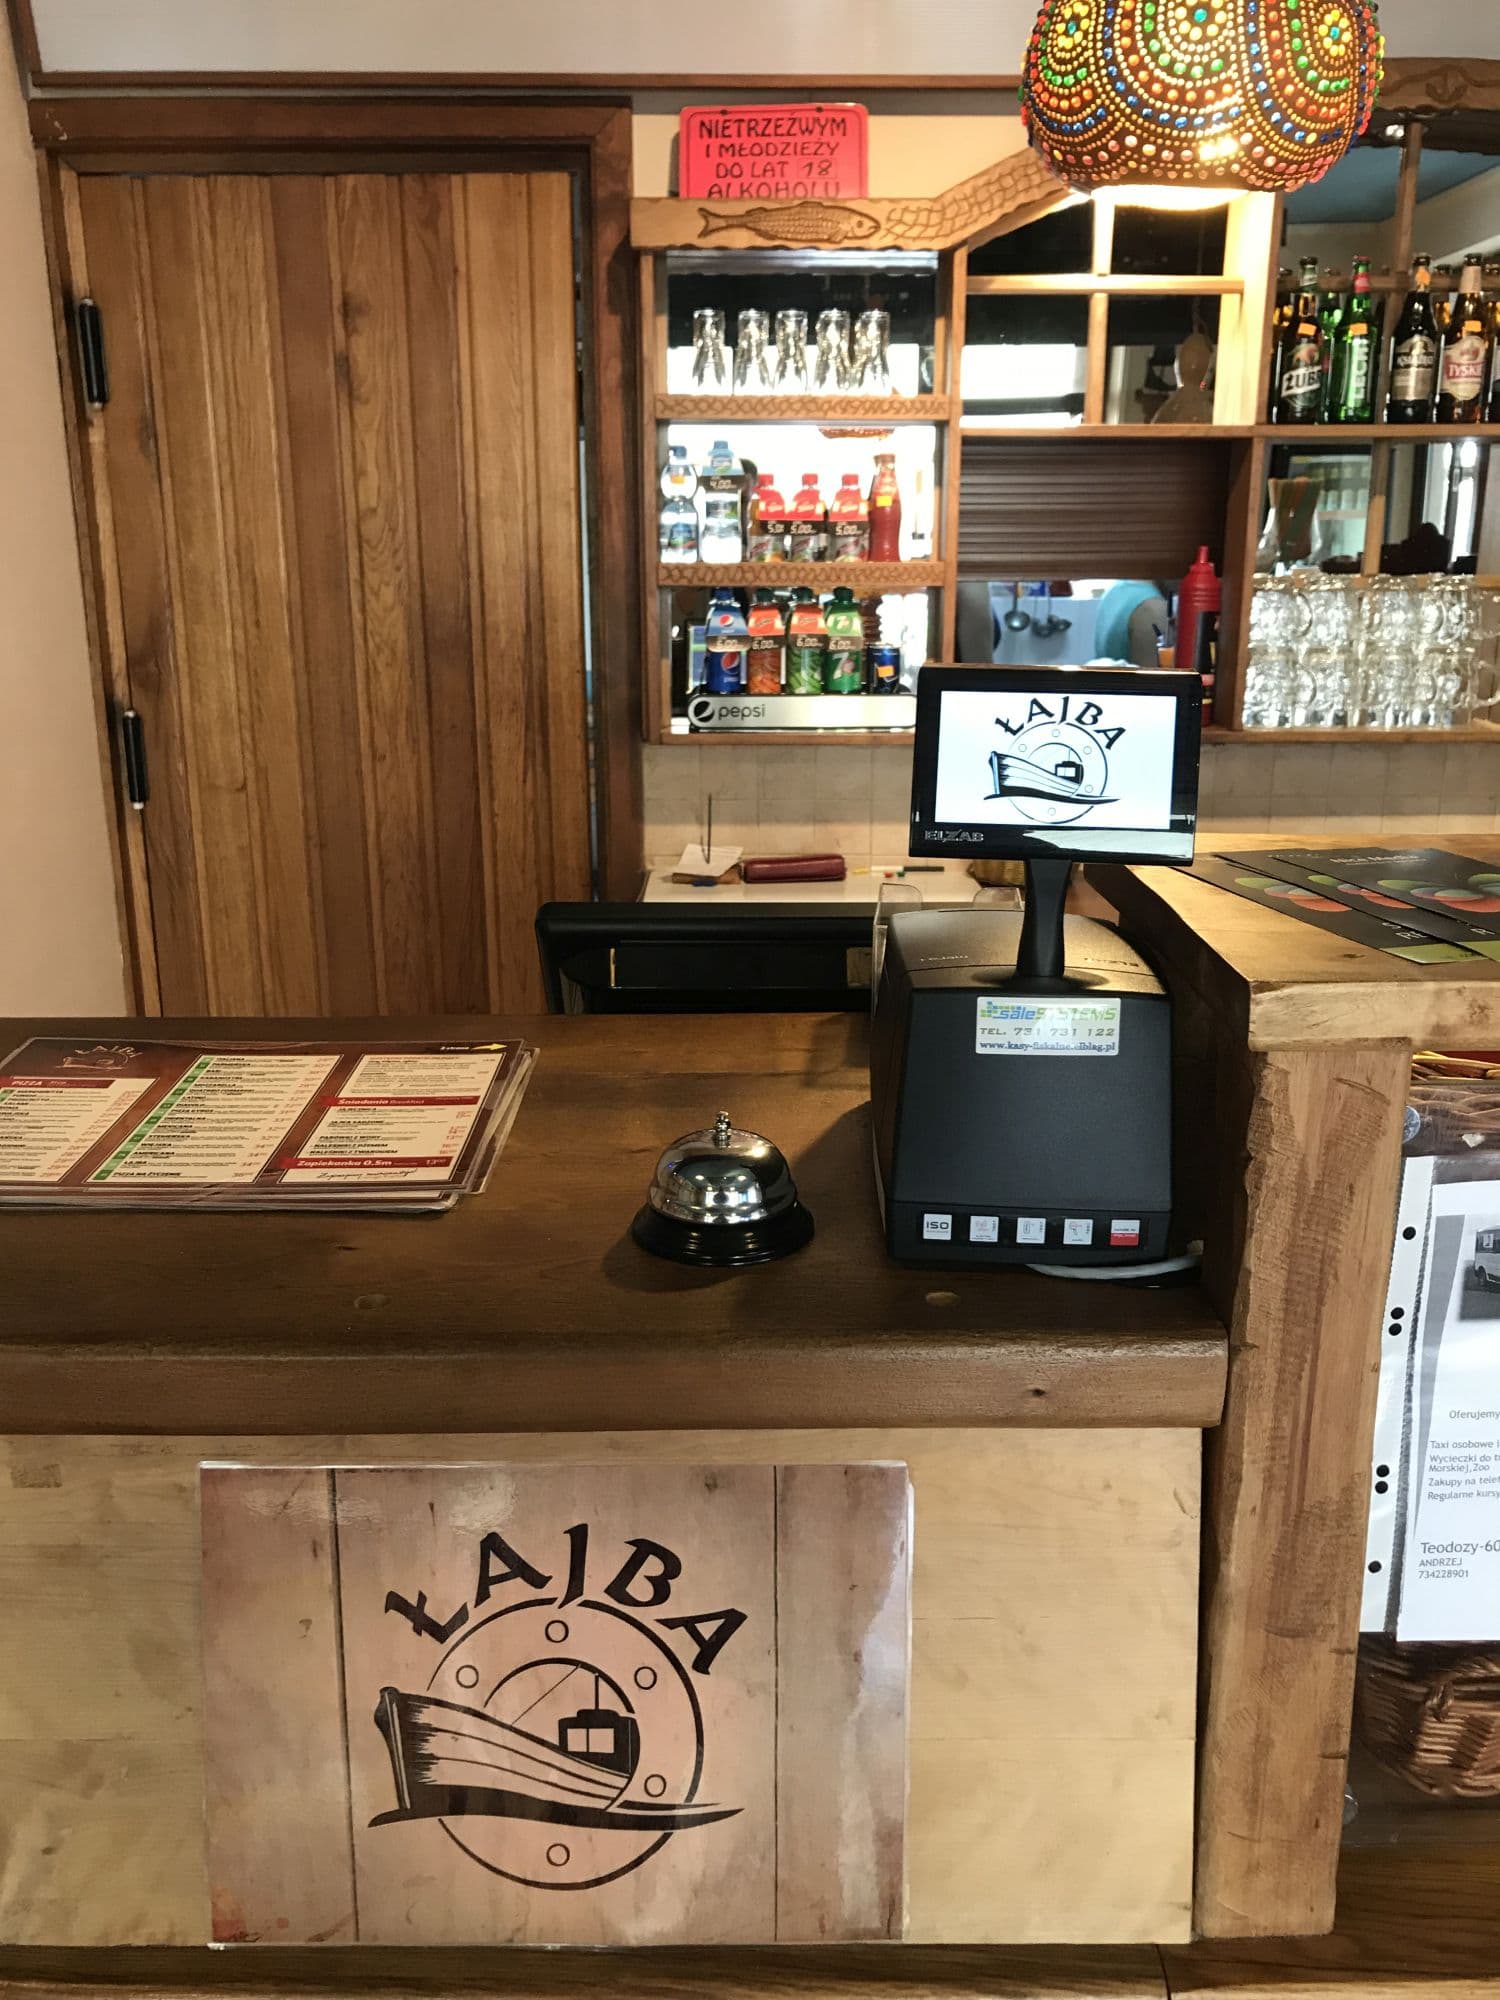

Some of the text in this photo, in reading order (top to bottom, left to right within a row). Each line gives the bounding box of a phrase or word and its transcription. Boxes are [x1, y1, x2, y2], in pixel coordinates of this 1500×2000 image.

[699, 112, 847, 139] NIETRZEŹWYM
[705, 138, 840, 158] I MŁODZIEŻY
[715, 159, 833, 179] DO LAT 18
[718, 703, 766, 724] pepsi
[995, 695, 1126, 750] ŁAJBA
[979, 1027, 1115, 1037] TEL. 731 731 122
[926, 1221, 949, 1230] ISO
[1448, 1410, 1500, 1421] Oferujemy
[1429, 1440, 1449, 1449] Taxi
[1451, 1440, 1494, 1449] osobowe
[1429, 1454, 1477, 1464] Wycieczki
[1479, 1454, 1492, 1462] do
[1428, 1477, 1463, 1487] Zakupy
[1427, 1491, 1474, 1502] Regularne
[1418, 1557, 1463, 1567] ANDRZEJ
[1418, 1569, 1469, 1579] 734228901
[384, 1522, 749, 1676] ŁAJBA
